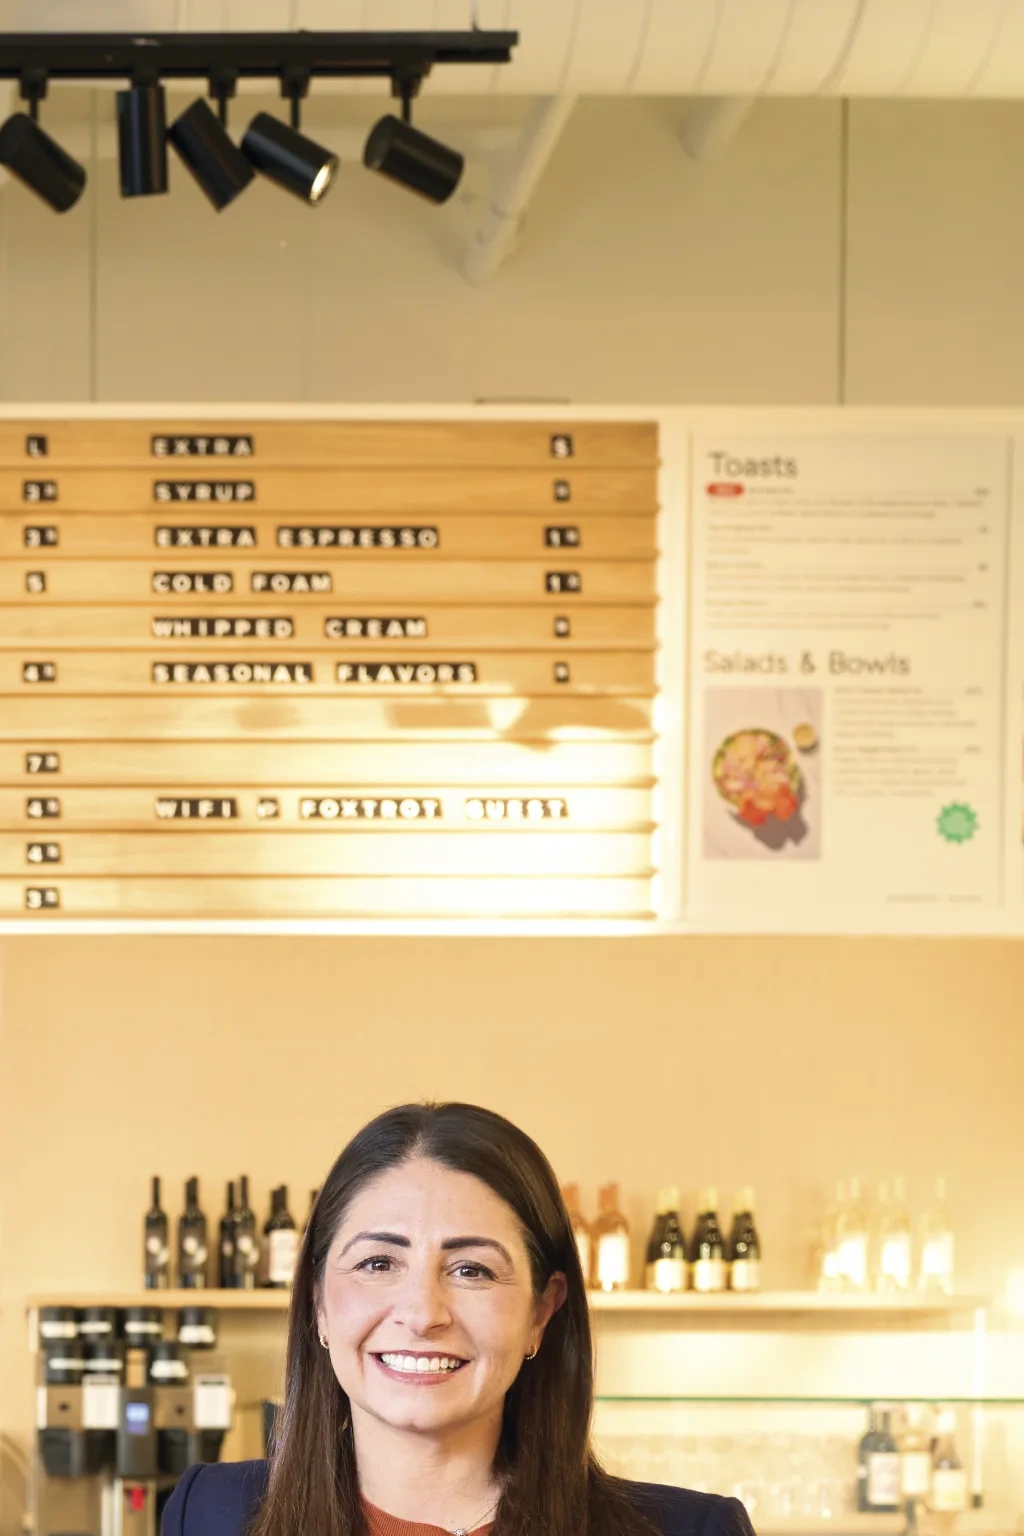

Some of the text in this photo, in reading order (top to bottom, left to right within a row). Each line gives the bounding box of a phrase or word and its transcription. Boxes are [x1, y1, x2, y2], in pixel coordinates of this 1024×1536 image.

[153, 437, 251, 456] EXTRA
[708, 450, 799, 478] Toasts
[155, 483, 253, 502] SYRUP
[156, 529, 438, 548] EXTRA ESPRESSO
[153, 573, 331, 592] COLD FOAM
[152, 618, 426, 637] WHIPPED CREAM
[703, 649, 911, 676] Salads & Bowls
[153, 664, 475, 683] SEASONAL FLAVORS
[156, 800, 232, 818] WIFI
[301, 799, 439, 818] FOXTROT
